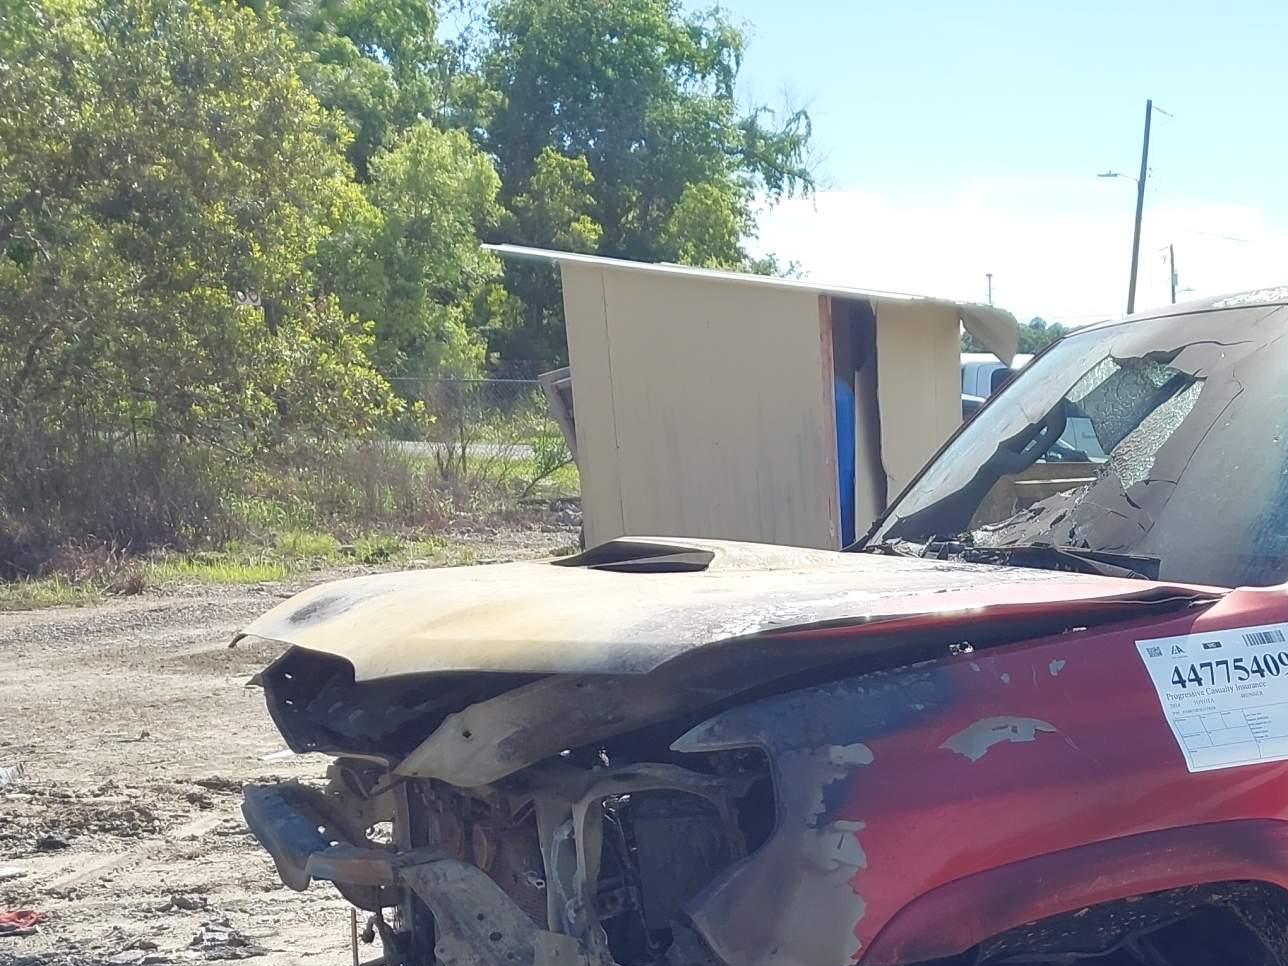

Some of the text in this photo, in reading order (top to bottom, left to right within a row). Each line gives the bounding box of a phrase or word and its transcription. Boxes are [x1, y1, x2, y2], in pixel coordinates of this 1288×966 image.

[1166, 680, 1267, 701] Progressive Casualty Insurance
